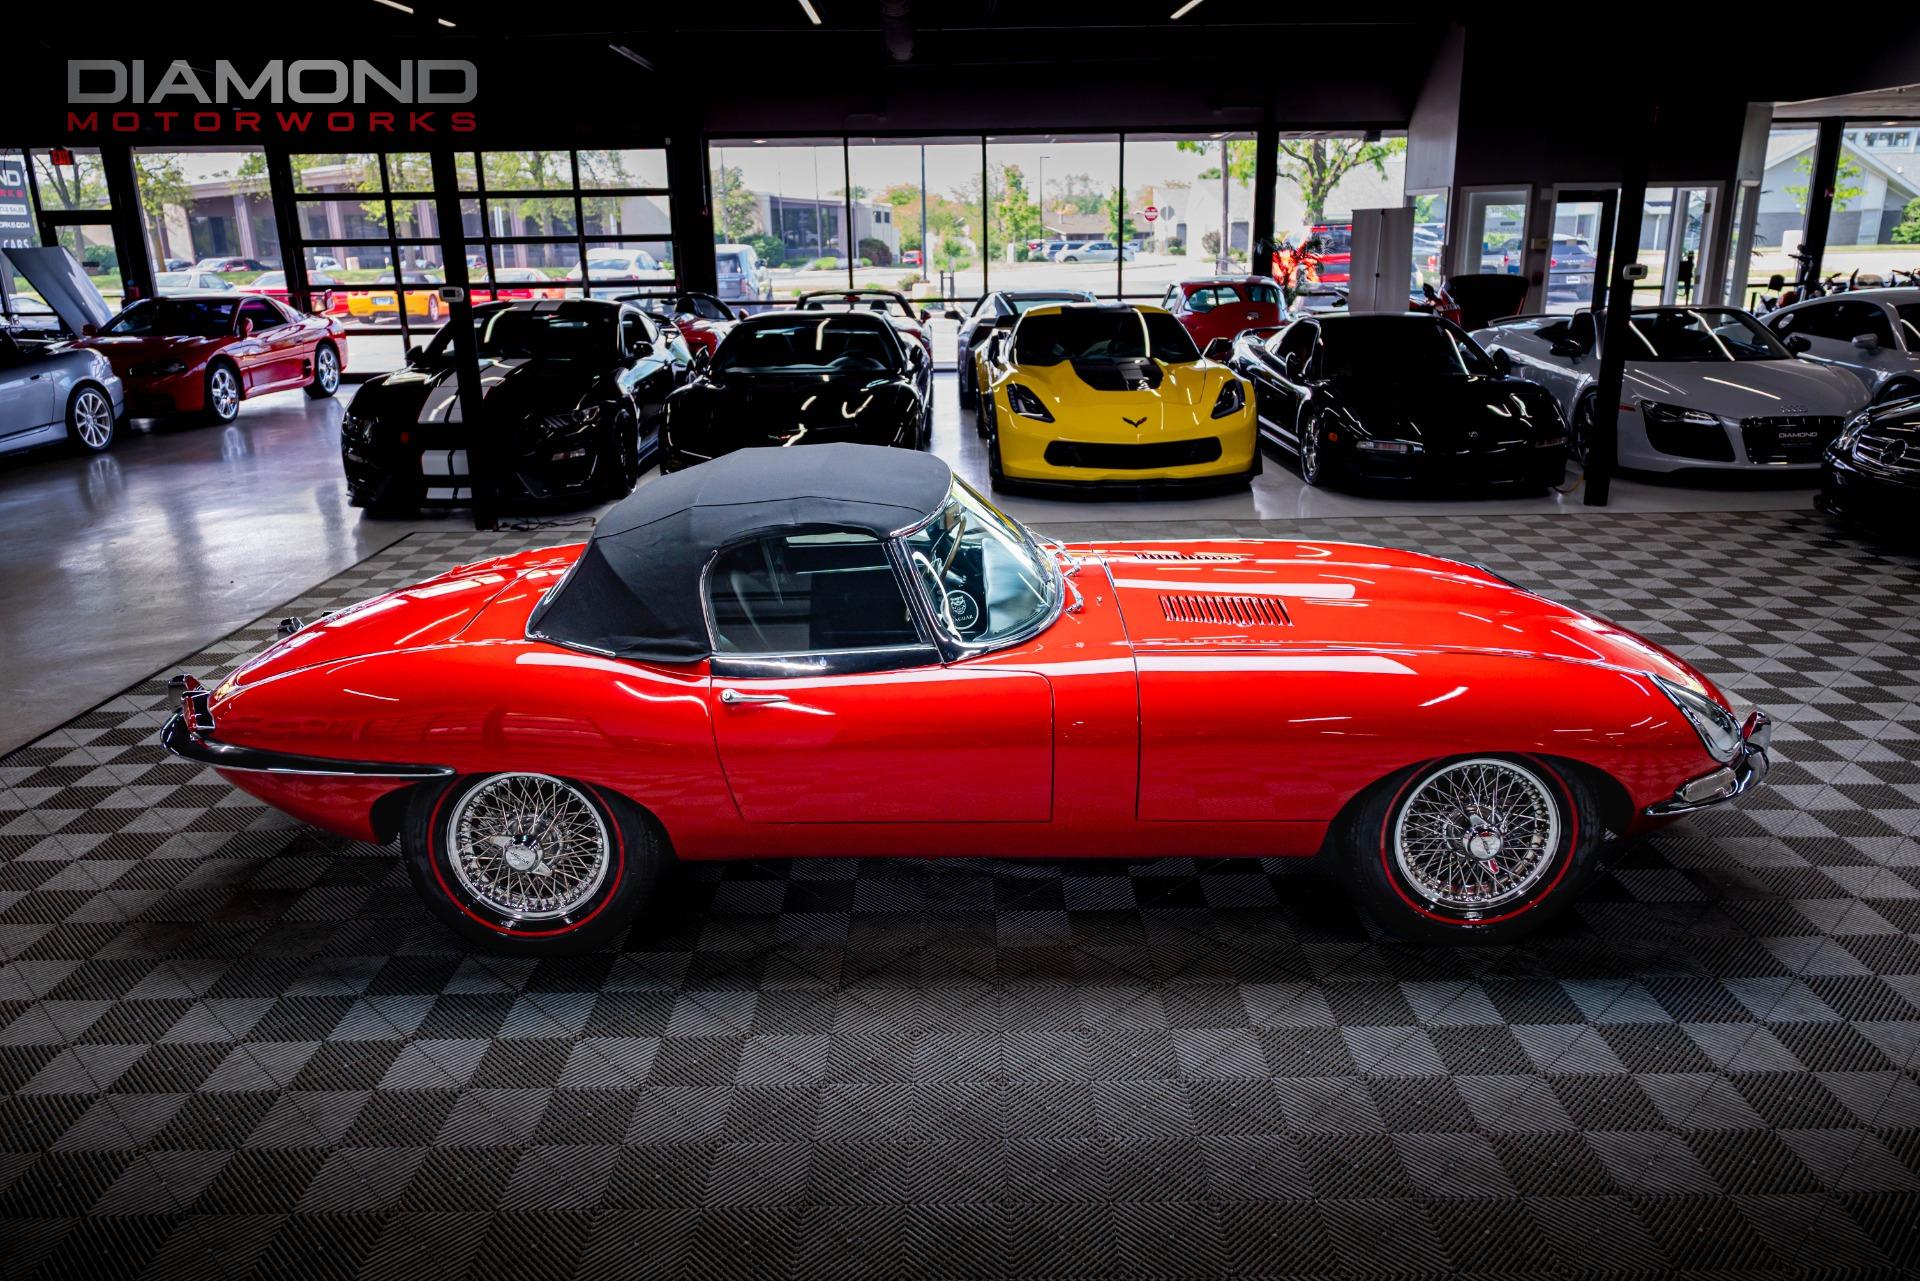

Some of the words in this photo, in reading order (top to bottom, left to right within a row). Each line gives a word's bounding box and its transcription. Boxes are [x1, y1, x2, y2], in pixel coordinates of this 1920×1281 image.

[3, 238, 30, 249] CARS
[1778, 431, 1818, 439] DIAMOND
[954, 613, 974, 623] AGUAR
